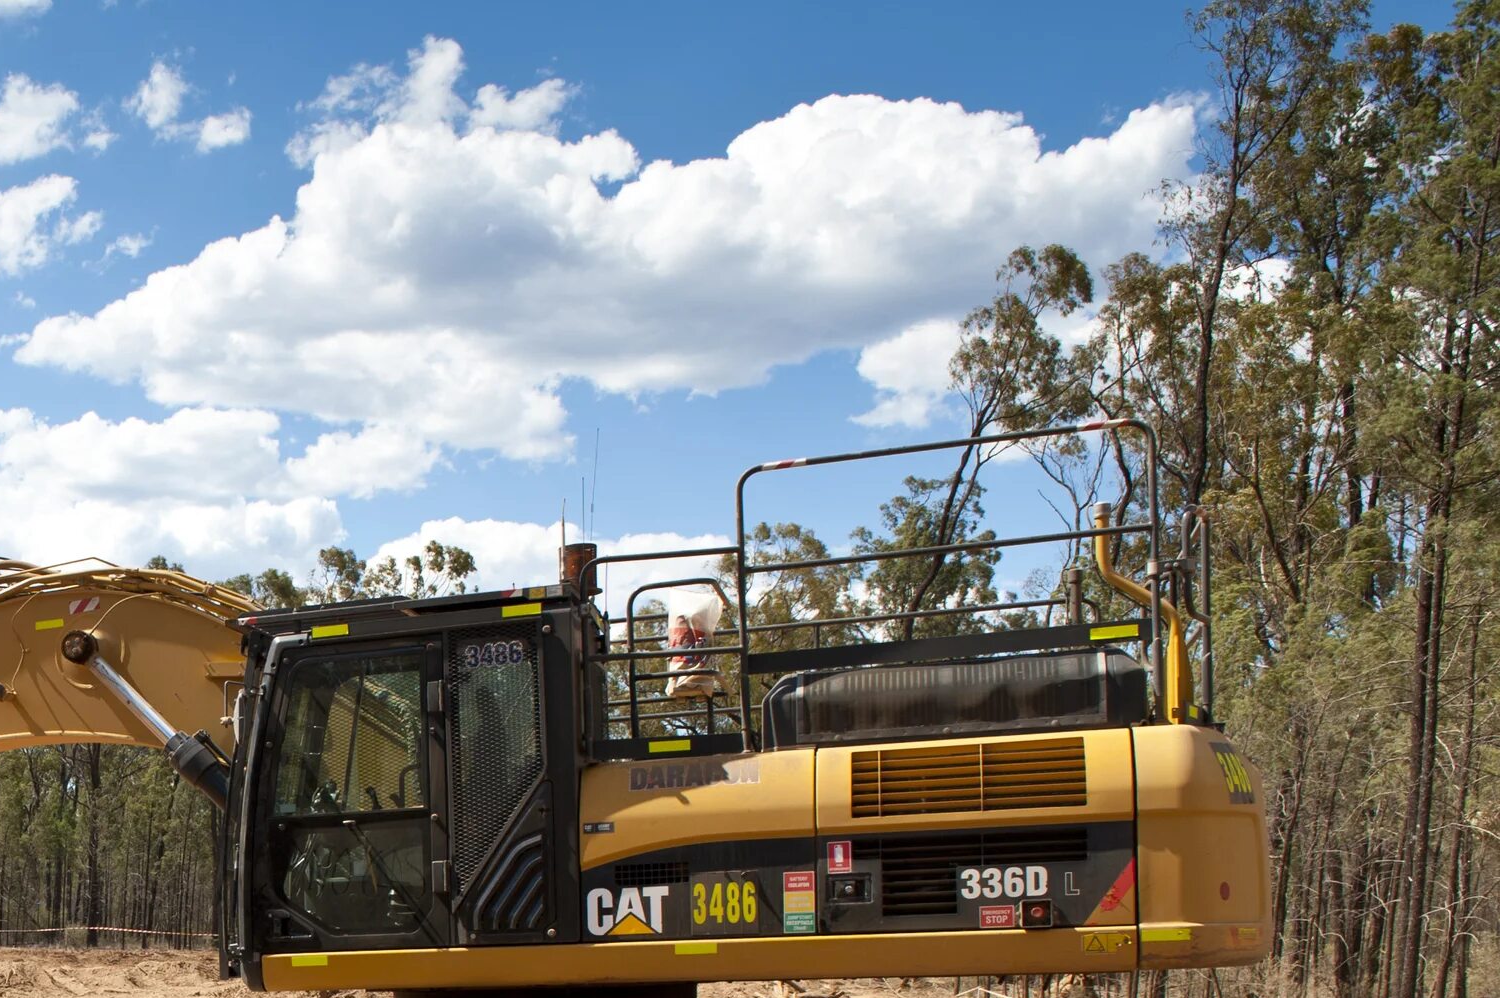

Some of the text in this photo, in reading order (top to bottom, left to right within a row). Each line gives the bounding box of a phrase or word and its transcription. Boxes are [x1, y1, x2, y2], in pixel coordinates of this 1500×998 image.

[465, 640, 523, 668] 3486
[960, 866, 1081, 899] 336D L
[587, 886, 669, 936] CAT
[693, 881, 757, 925] 3486
[985, 915, 1008, 924] STOP
